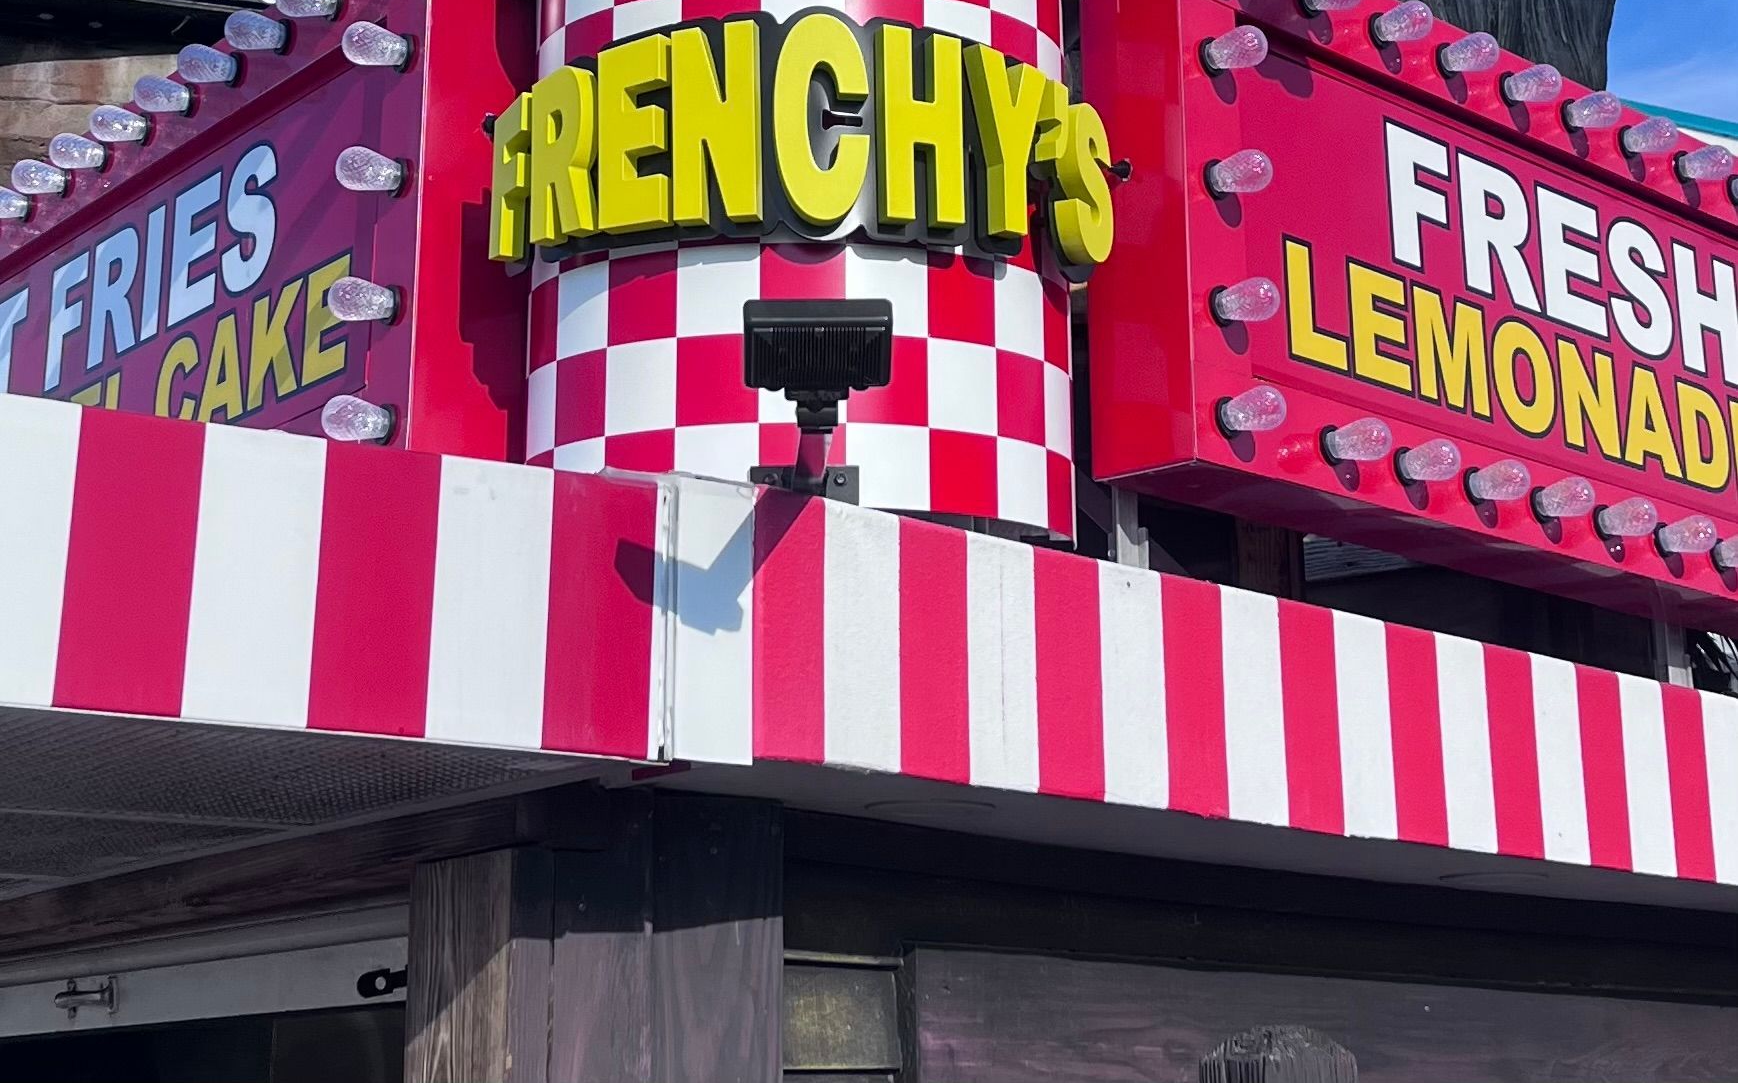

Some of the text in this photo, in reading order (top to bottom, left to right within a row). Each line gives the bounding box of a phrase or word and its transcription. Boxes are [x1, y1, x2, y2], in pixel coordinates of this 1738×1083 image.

[488, 12, 1114, 264] FRENCHY'S
[1384, 119, 1738, 386] FRESH
[43, 143, 278, 393] FRIES
[154, 253, 351, 423] CAKE
[1284, 238, 1738, 491] LEMONAD
